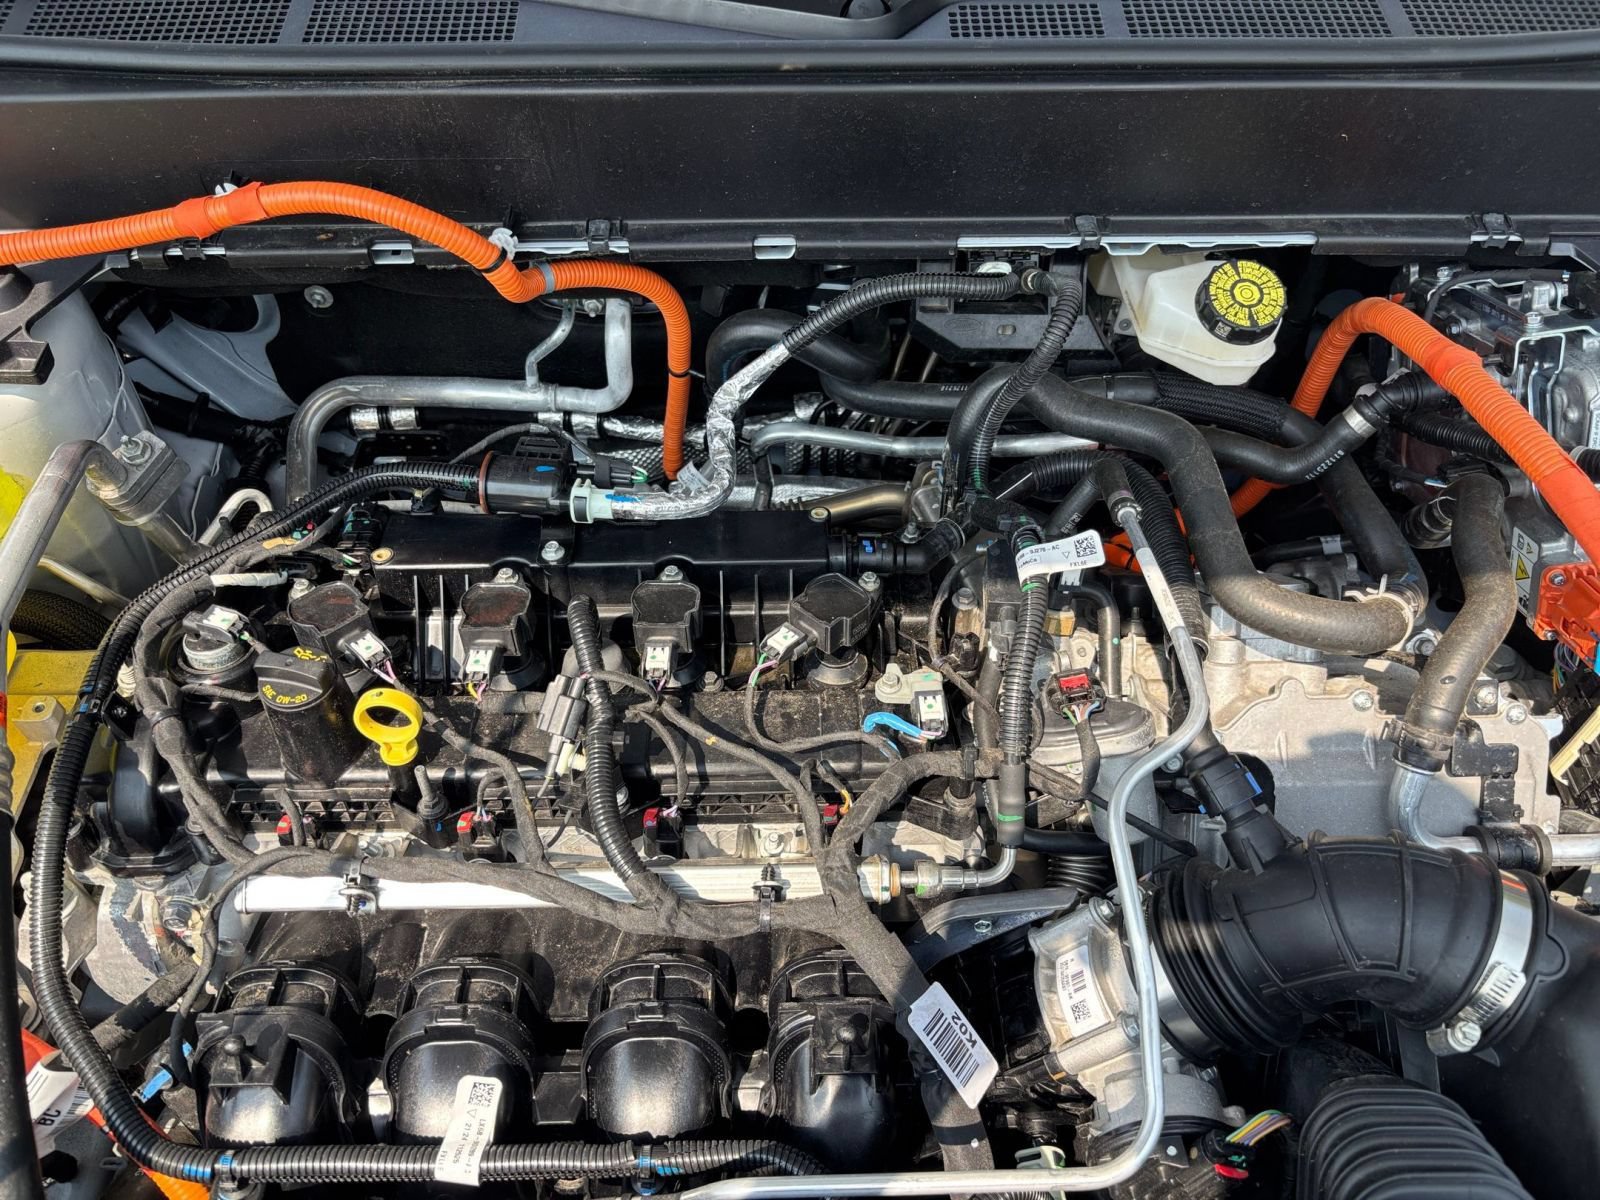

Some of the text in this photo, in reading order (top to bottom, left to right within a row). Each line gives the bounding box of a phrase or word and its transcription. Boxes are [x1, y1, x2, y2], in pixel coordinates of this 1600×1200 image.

[262, 684, 308, 705] SAE 0W-20
[951, 1011, 978, 1049] K02
